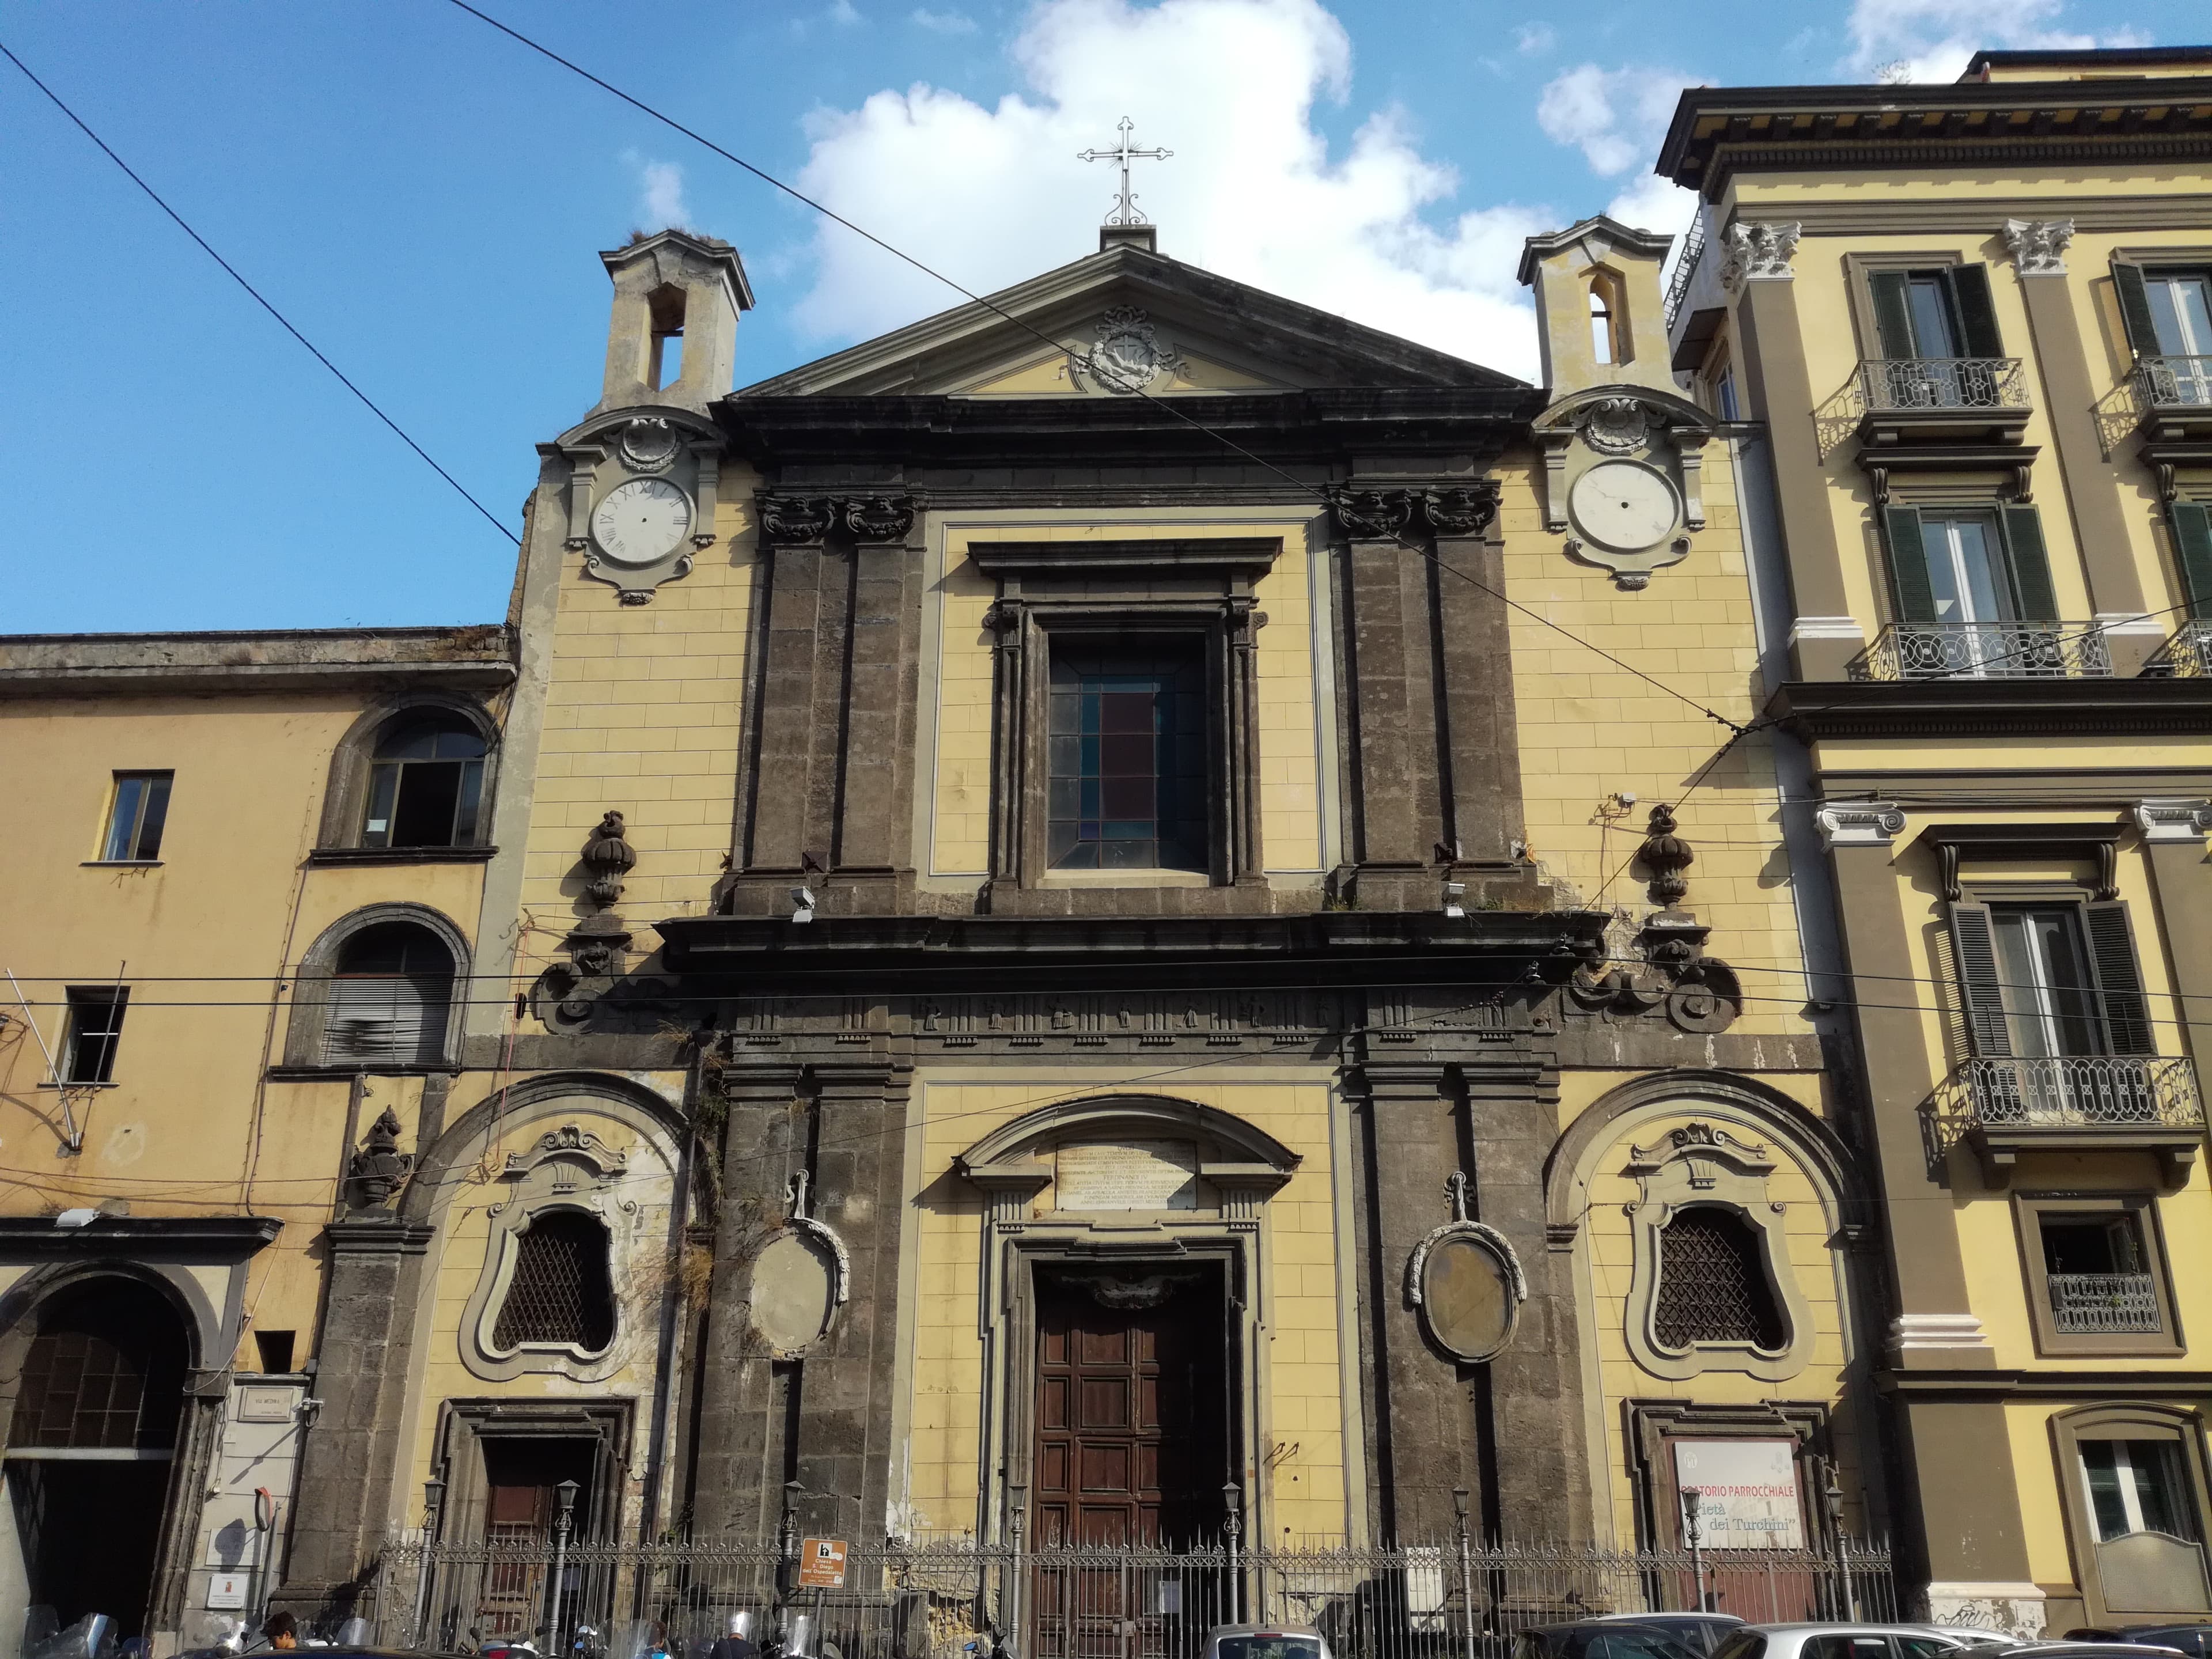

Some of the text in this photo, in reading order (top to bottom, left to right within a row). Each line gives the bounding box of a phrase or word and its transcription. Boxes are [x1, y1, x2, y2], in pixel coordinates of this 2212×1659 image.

[606, 497, 621, 509] X
[599, 514, 615, 524] IX
[673, 516, 689, 525] III
[1729, 1486, 1794, 1497] PARROCCHIALE
[1710, 1517, 1730, 1531] dei
